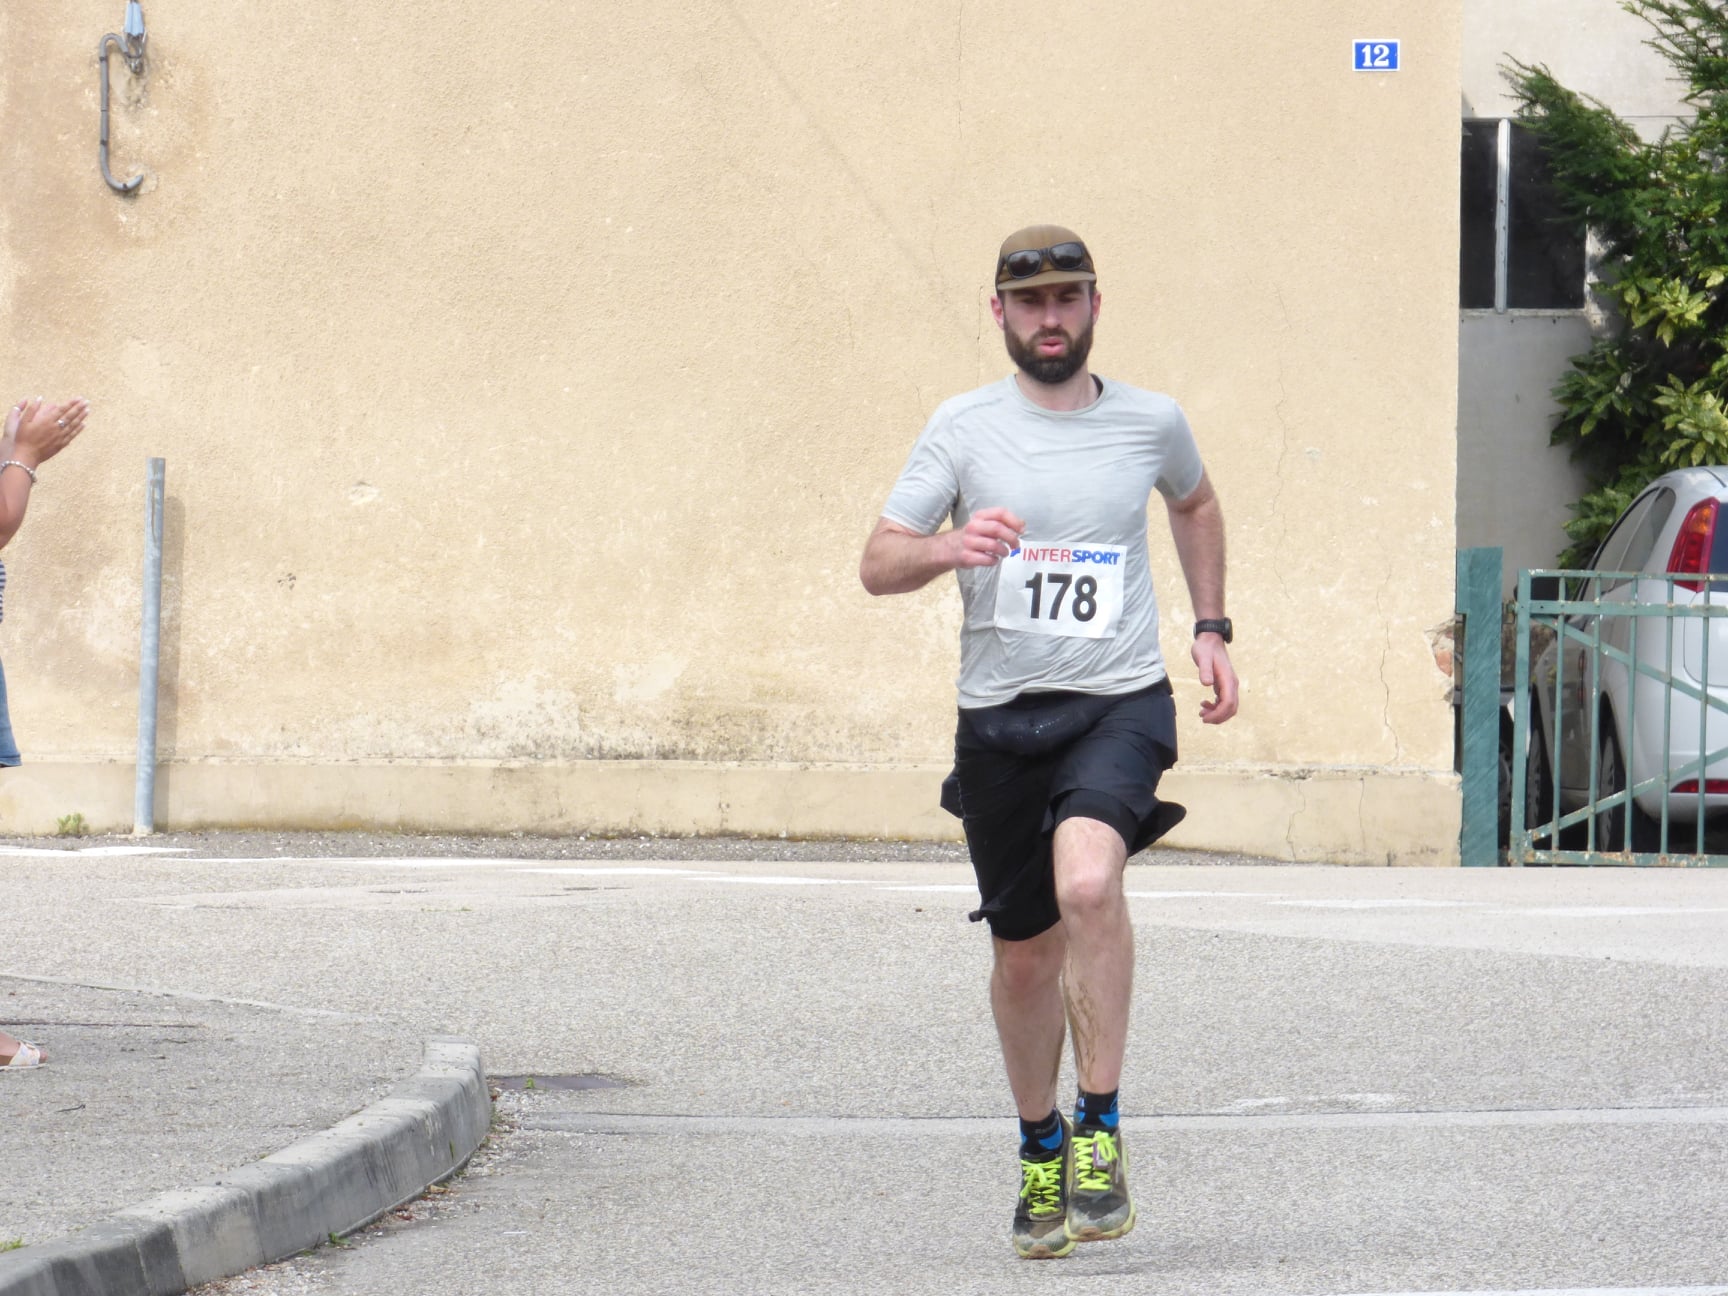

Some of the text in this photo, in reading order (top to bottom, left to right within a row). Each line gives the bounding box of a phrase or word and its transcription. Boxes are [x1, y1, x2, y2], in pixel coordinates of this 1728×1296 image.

[1361, 44, 1390, 67] 12
[1022, 547, 1121, 565] INTERSPORT
[1024, 571, 1098, 622] 178
